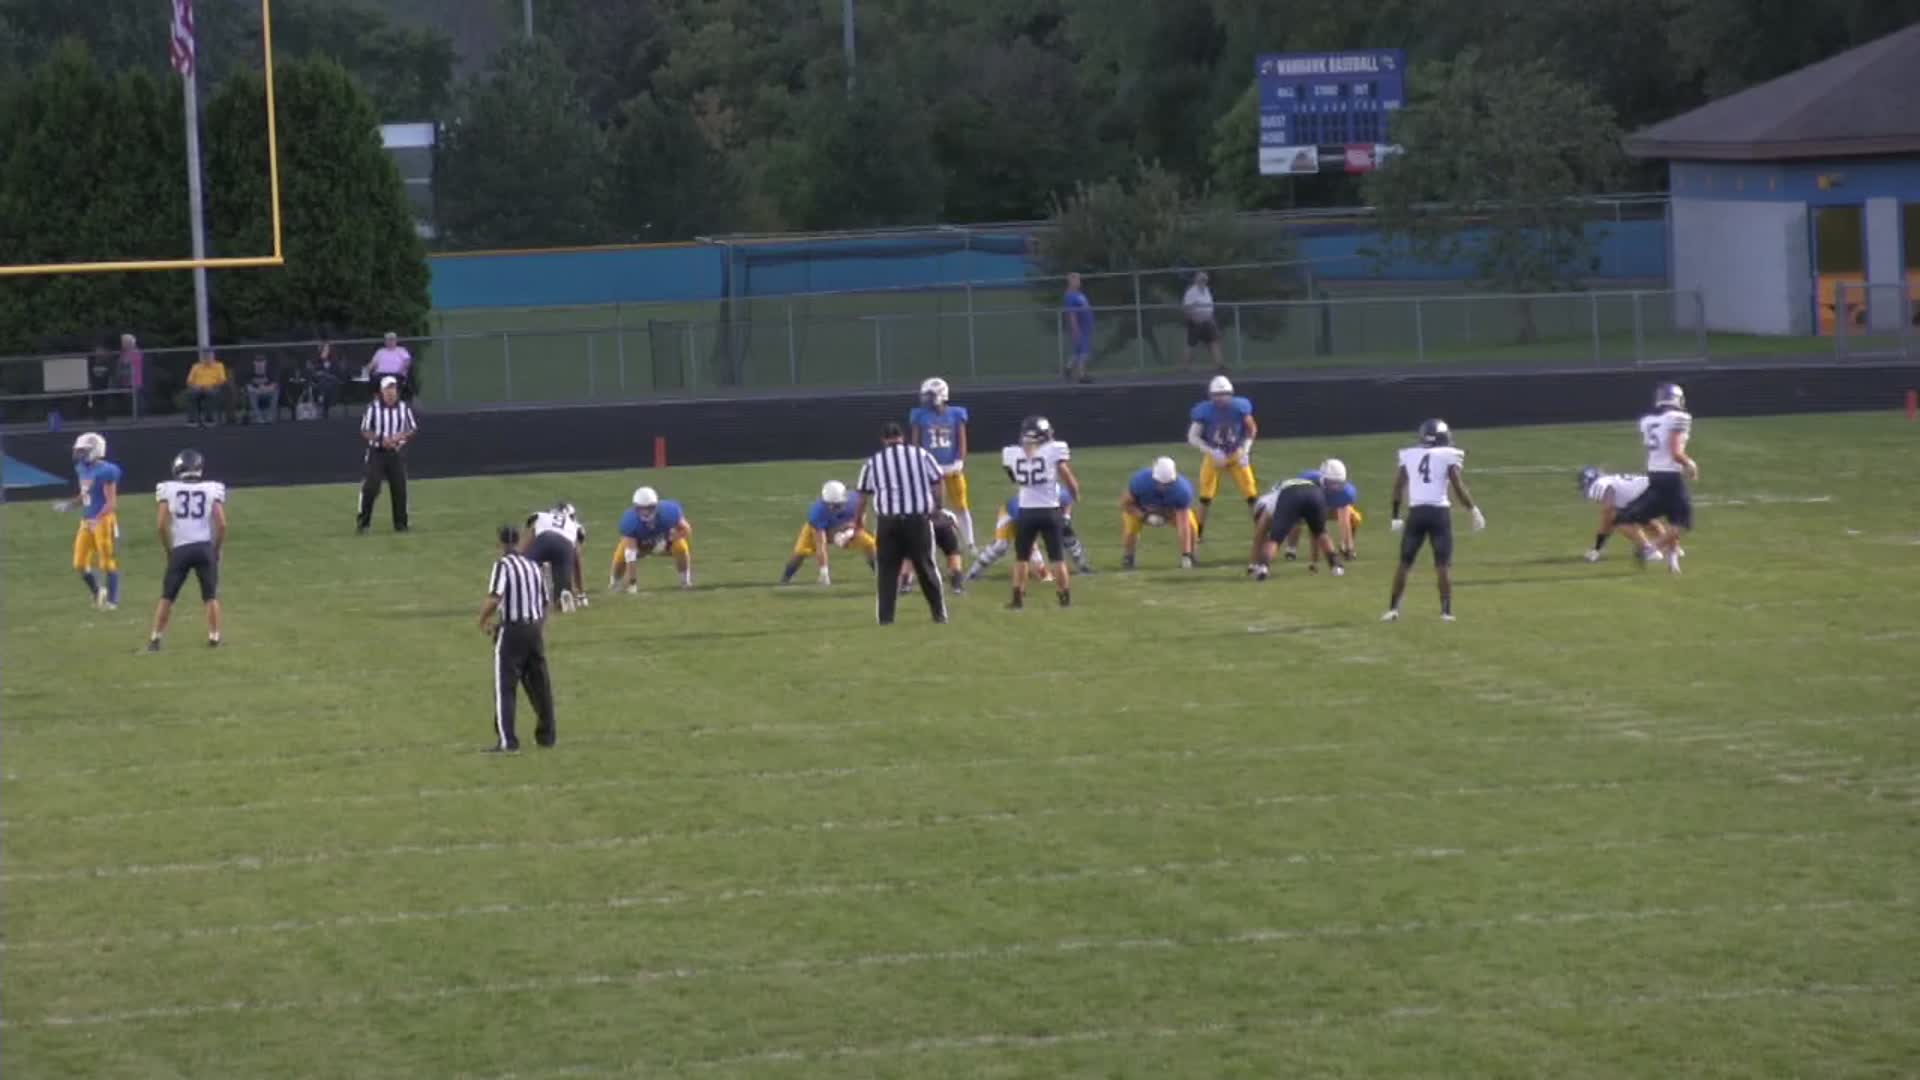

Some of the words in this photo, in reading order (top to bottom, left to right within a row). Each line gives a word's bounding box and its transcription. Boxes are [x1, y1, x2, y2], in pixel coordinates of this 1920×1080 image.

[1016, 456, 1047, 486] 52
[1418, 453, 1432, 484] 4
[176, 490, 206, 519] 33
